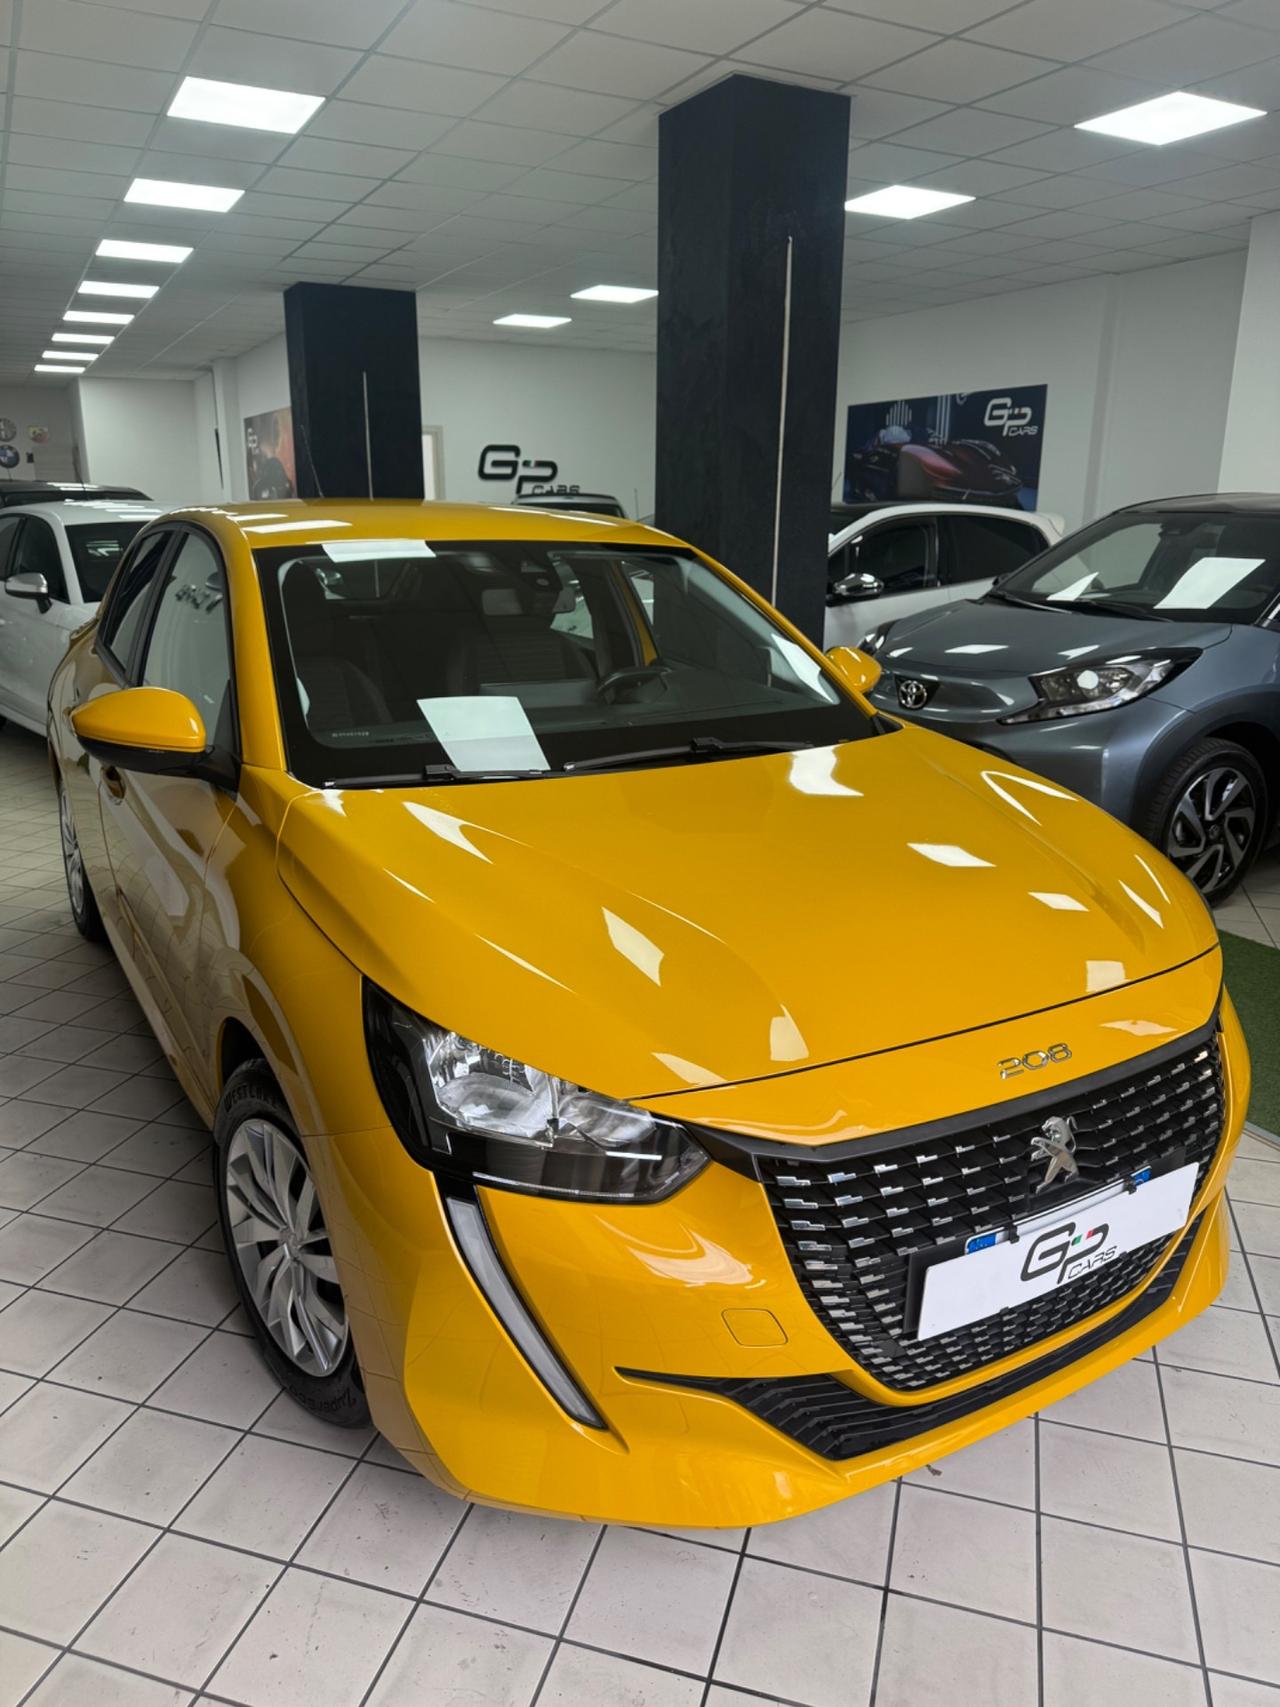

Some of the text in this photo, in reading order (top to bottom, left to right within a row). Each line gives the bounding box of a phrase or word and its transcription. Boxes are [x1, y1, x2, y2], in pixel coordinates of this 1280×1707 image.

[984, 397, 1032, 437] GP
[1008, 426, 1039, 437] CARS
[478, 444, 558, 495] GP
[532, 485, 581, 495] CARS
[997, 1042, 1073, 1080] 208
[1020, 1222, 1109, 1285] GP
[1067, 1245, 1118, 1279] CARS
